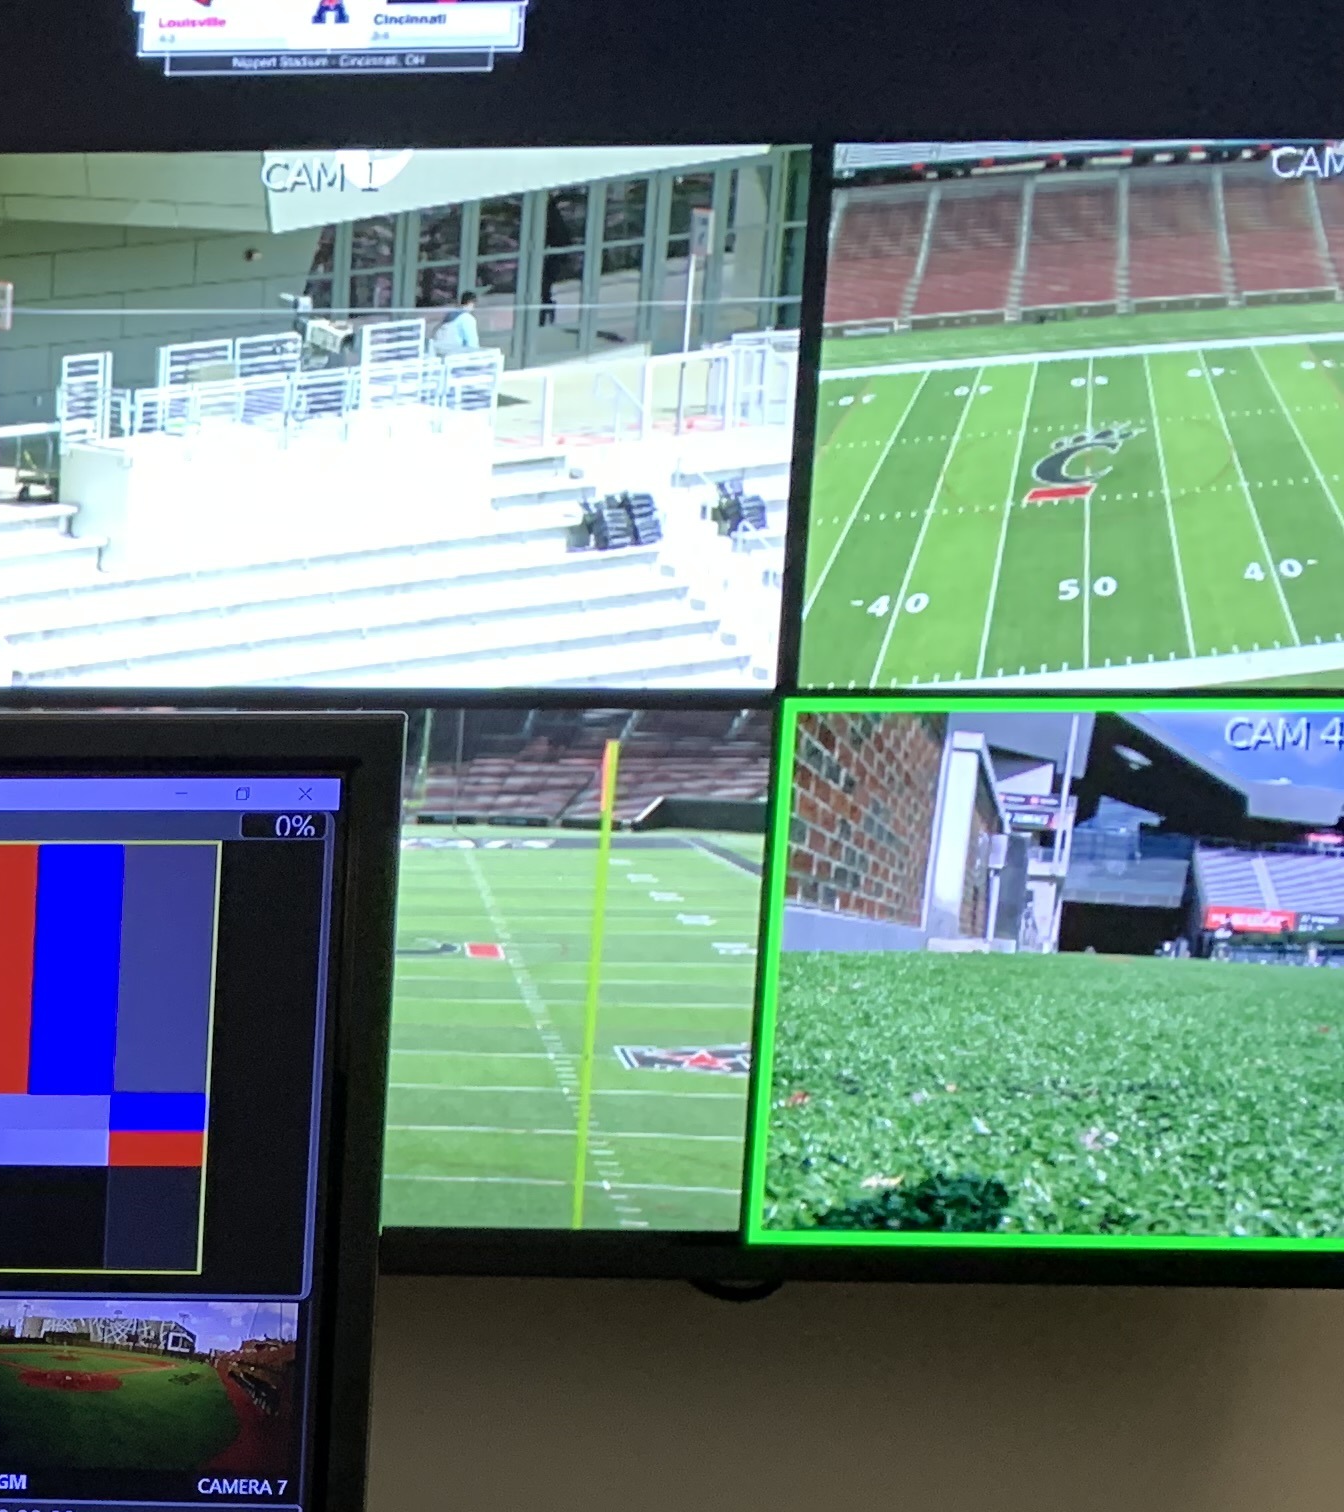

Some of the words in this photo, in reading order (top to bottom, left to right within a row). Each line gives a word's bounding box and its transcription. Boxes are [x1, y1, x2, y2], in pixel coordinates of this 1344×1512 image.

[262, 161, 346, 192] CAM
[362, 162, 379, 192] 1
[1057, 576, 1117, 601] 50
[1225, 718, 1310, 752] CAM
[1320, 718, 1344, 752] 4
[275, 816, 315, 838] 0%
[197, 1478, 272, 1495] CAMERA
[276, 1480, 288, 1496] 7
